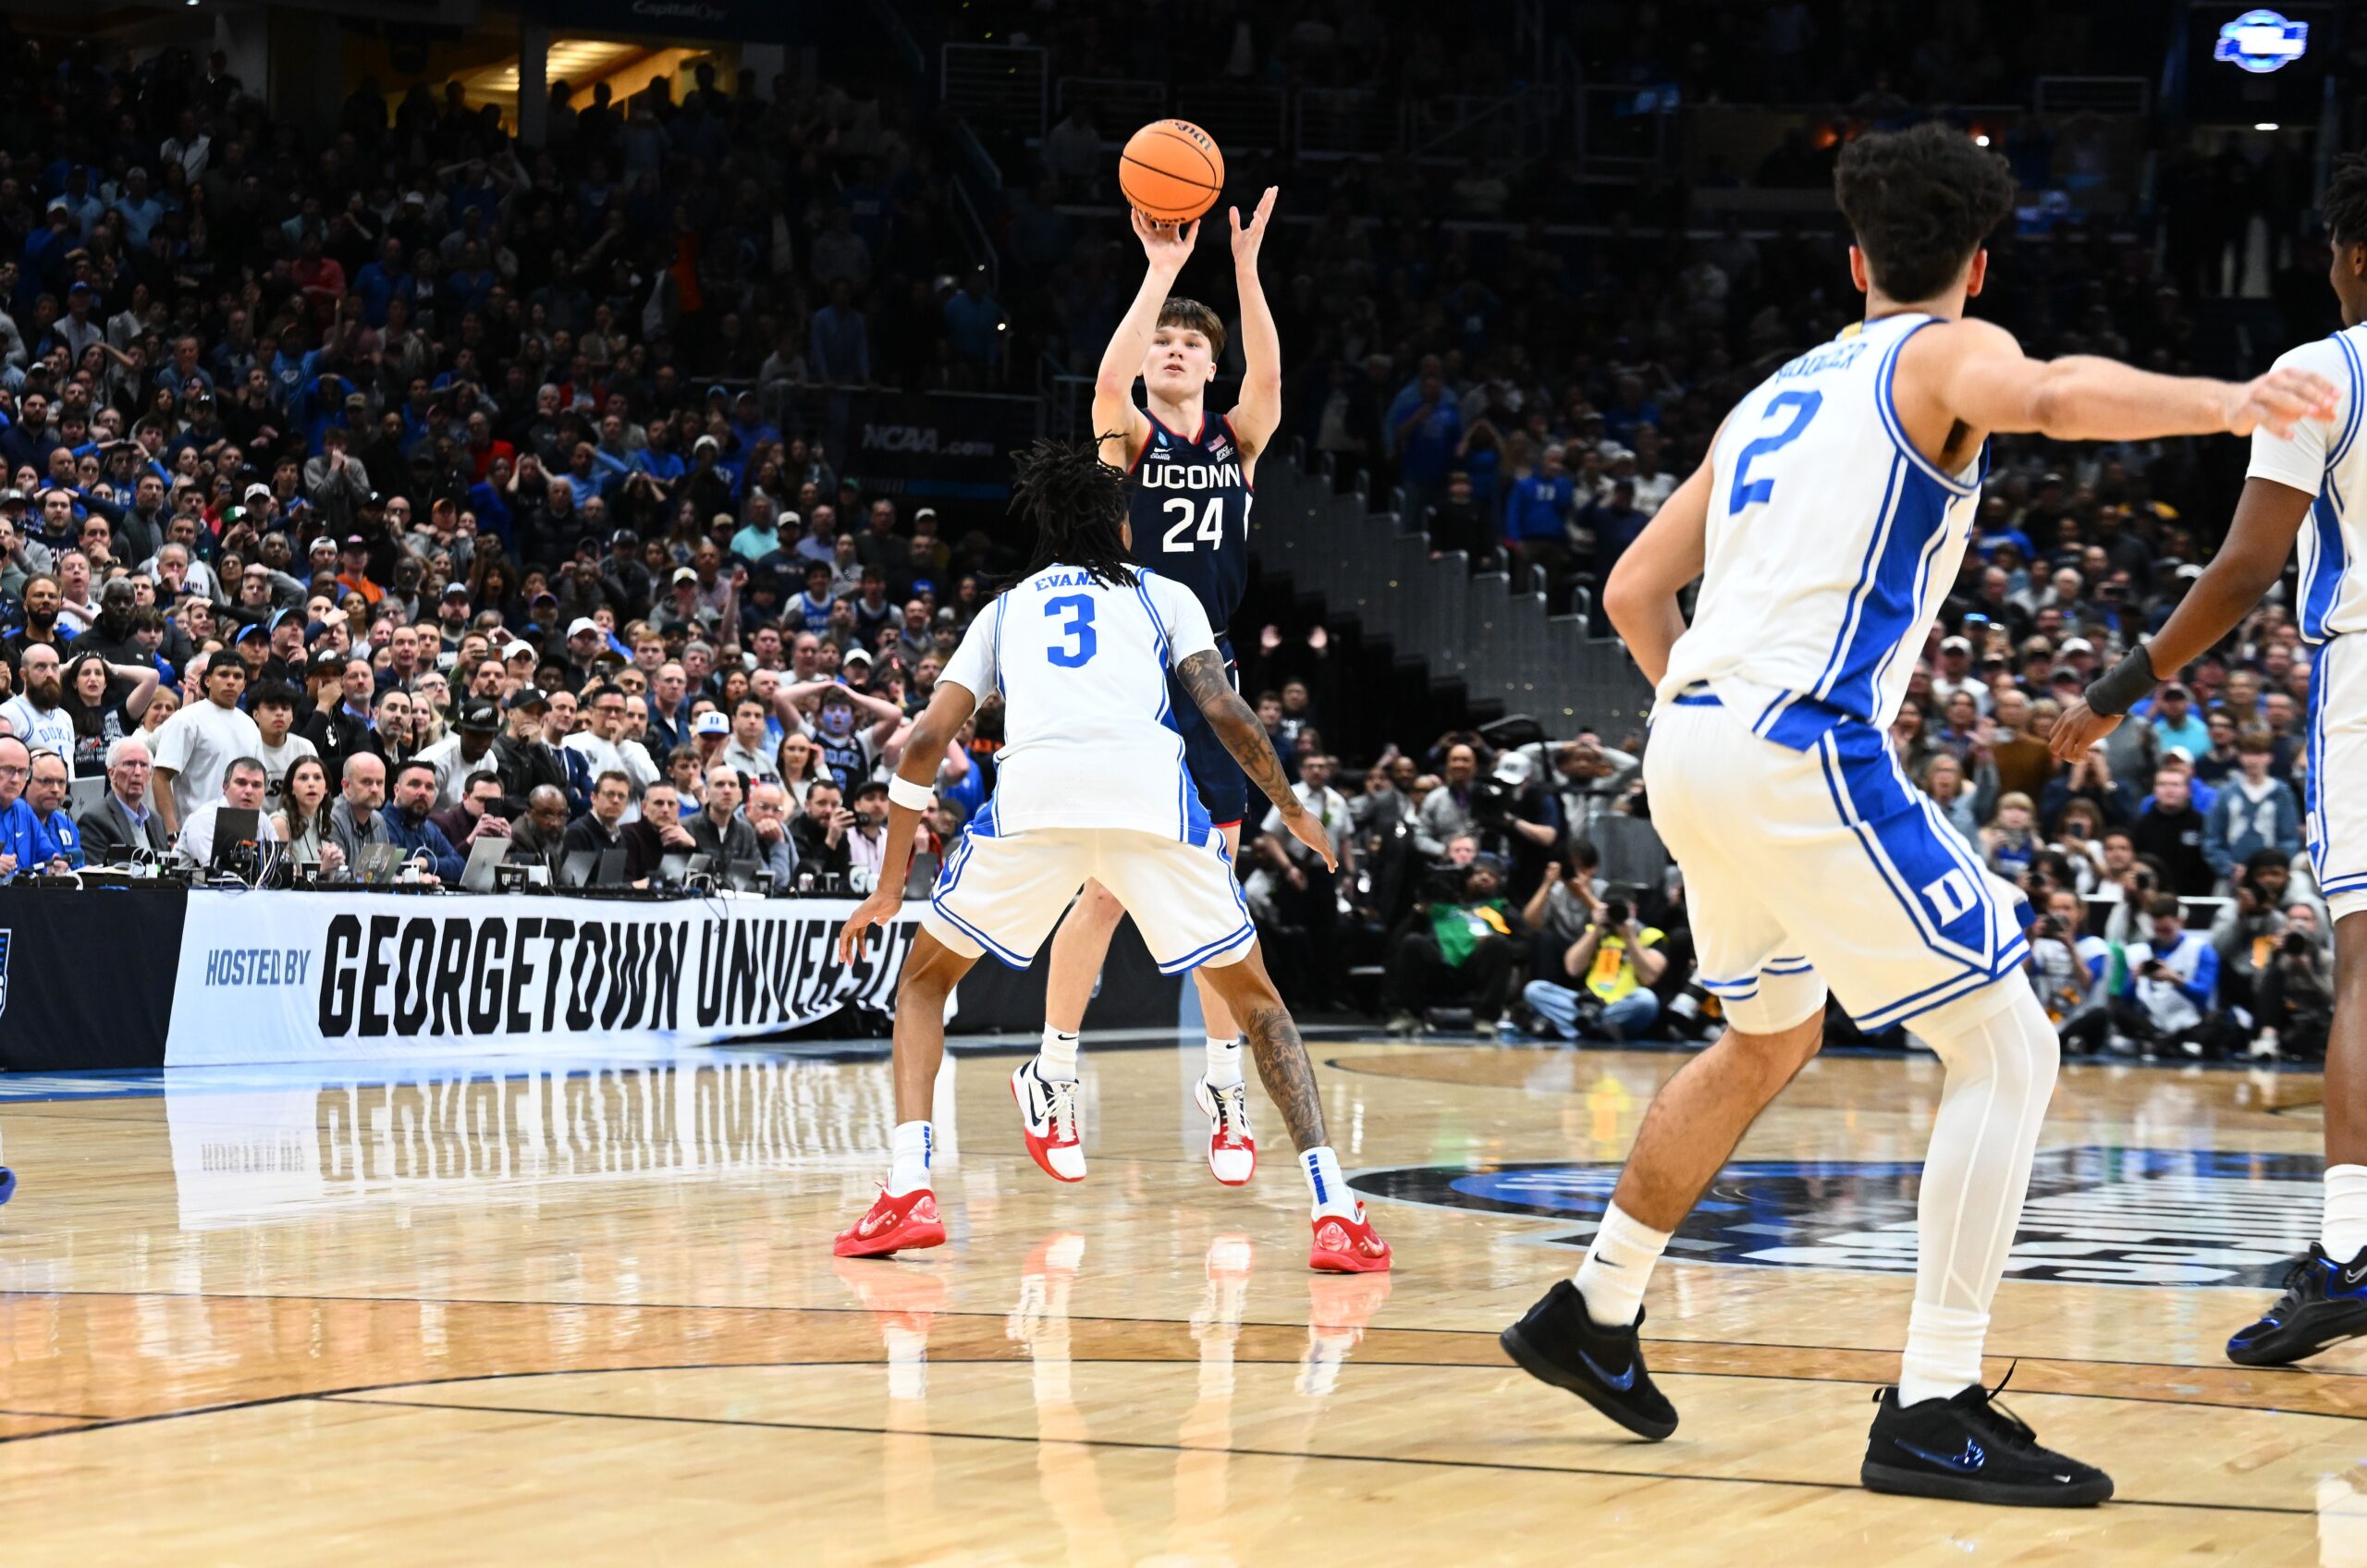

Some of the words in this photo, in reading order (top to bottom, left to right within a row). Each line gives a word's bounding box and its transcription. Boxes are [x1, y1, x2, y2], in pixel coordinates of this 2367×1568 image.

[1142, 463, 1241, 489] UCONN
[1729, 390, 1823, 516] 2
[1162, 497, 1223, 553] 24
[1044, 593, 1098, 668] 3
[1921, 867, 1978, 928] D
[205, 949, 280, 986] HOSTED
[284, 949, 311, 986] BY
[318, 913, 689, 1037] GEORGETOWN
